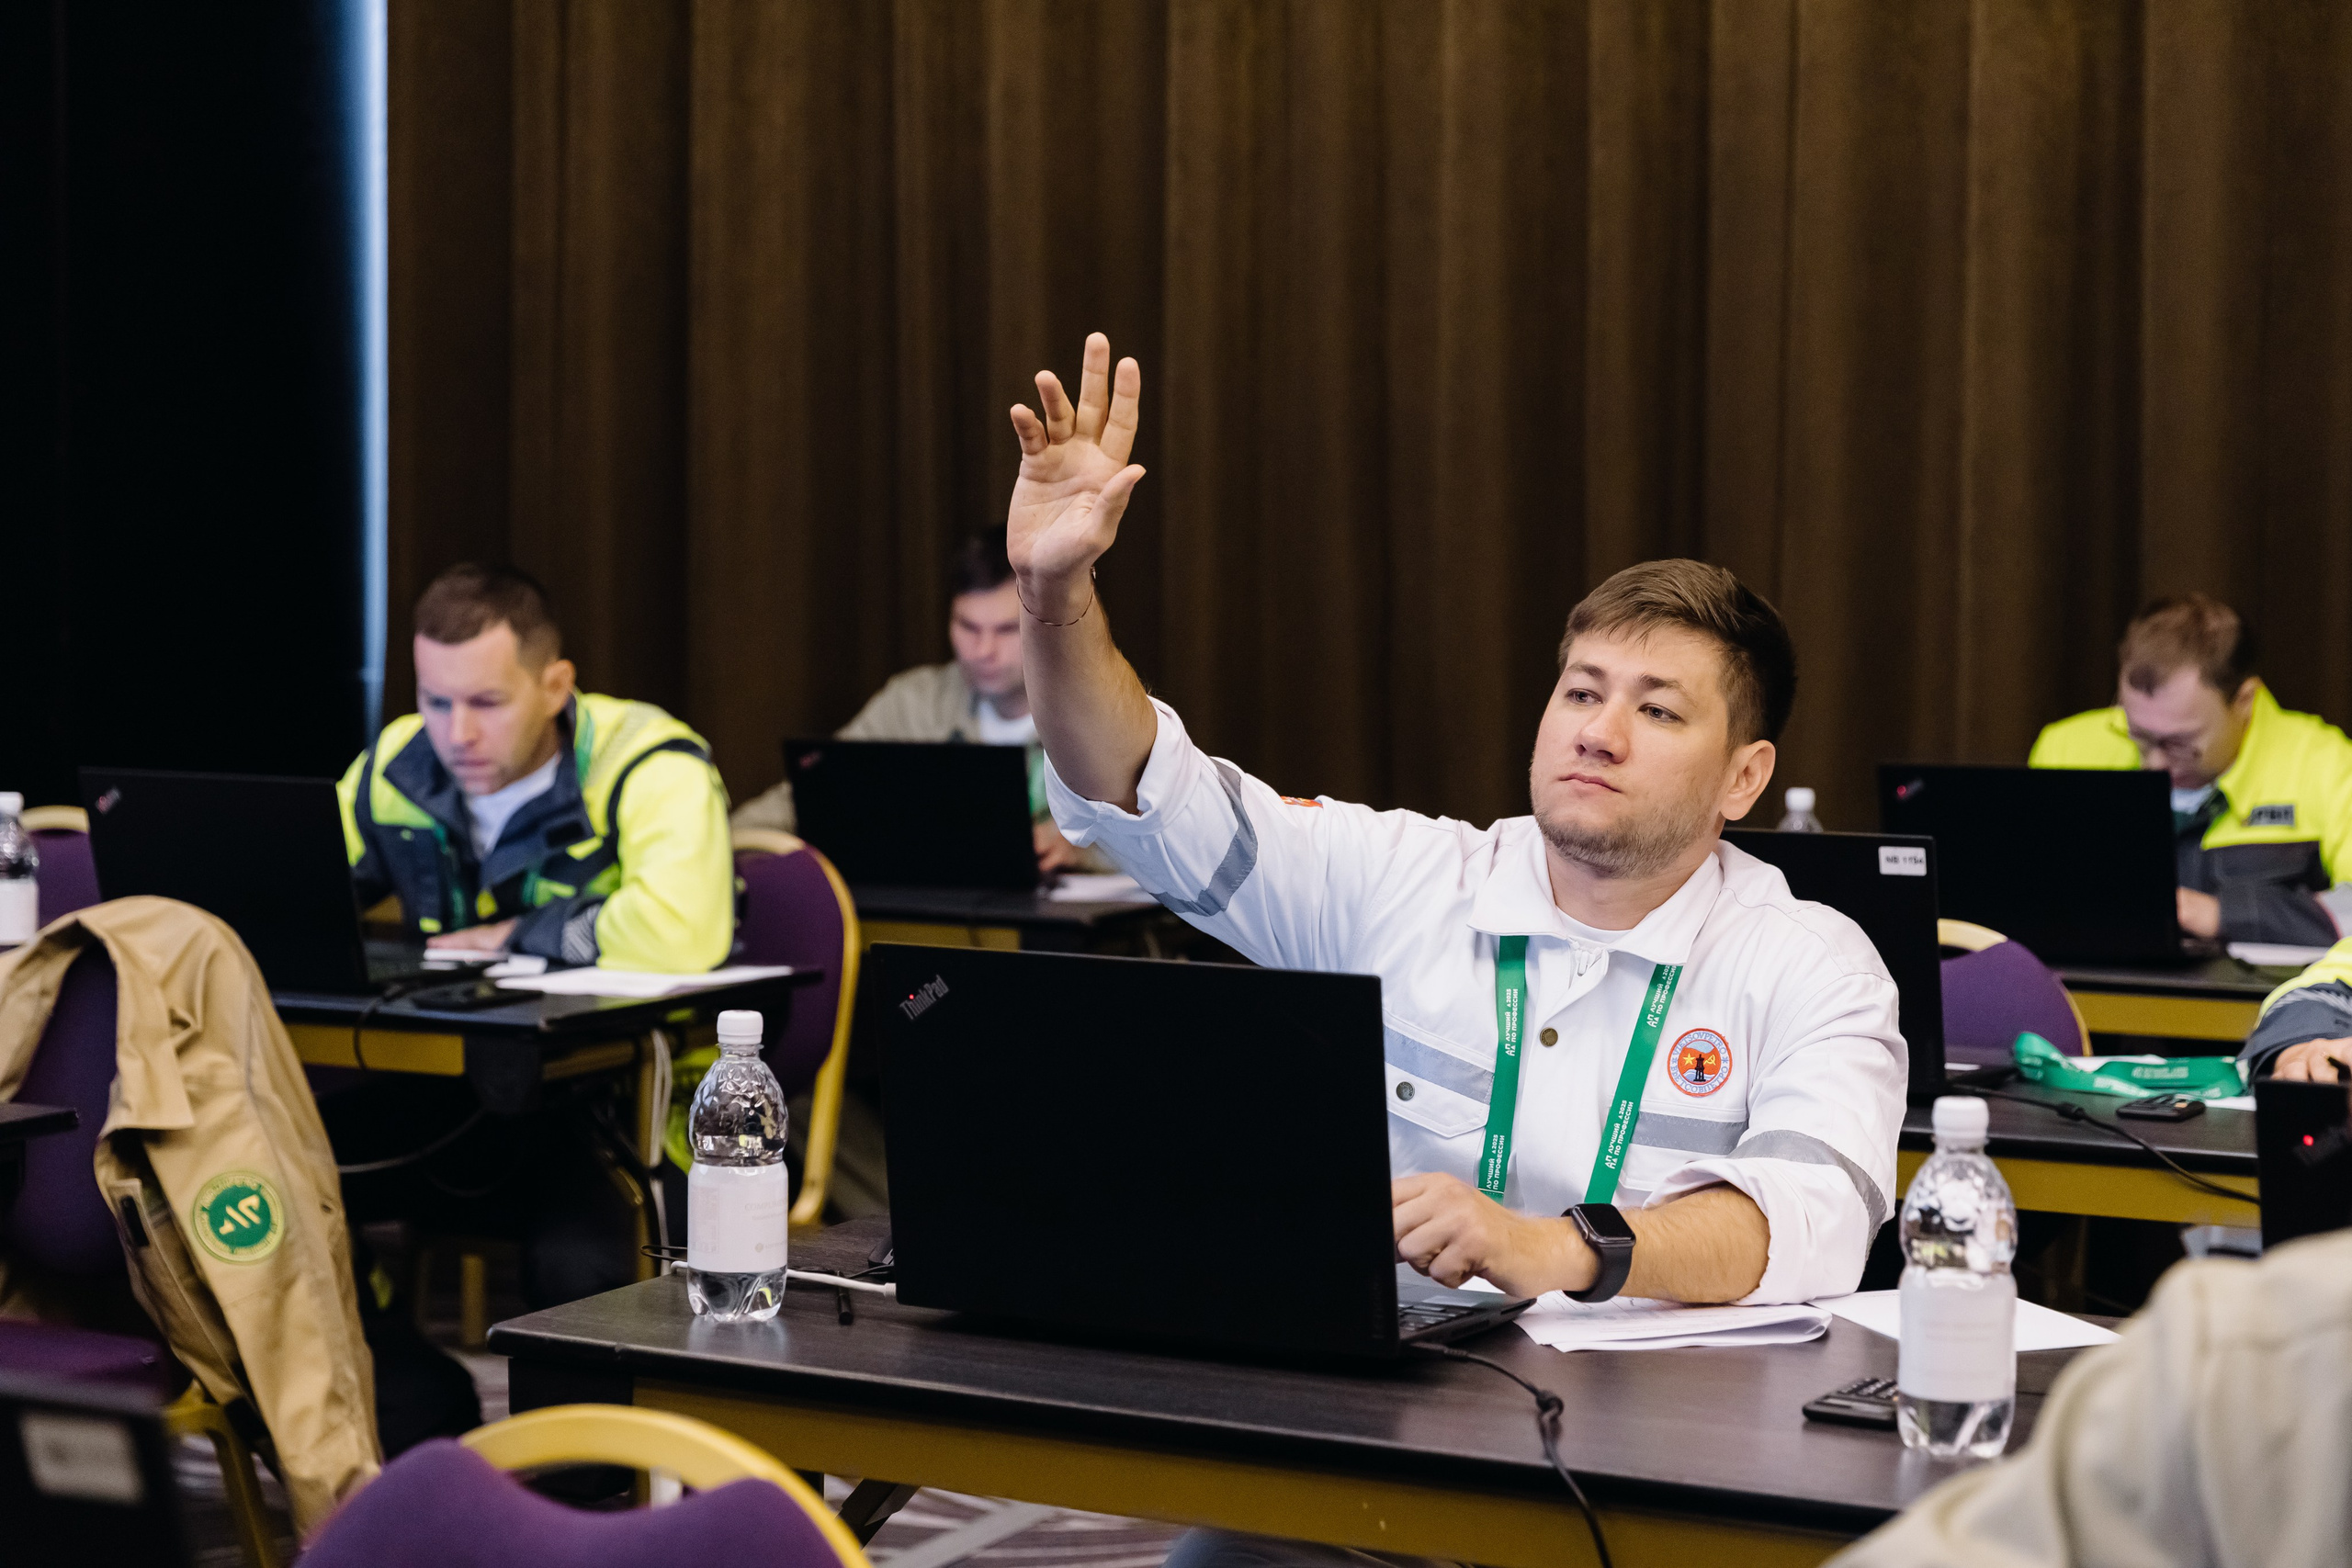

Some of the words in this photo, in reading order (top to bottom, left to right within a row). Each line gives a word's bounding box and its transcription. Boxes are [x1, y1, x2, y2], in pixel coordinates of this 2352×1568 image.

[899, 974, 950, 1020] ThinkPad
[1650, 984, 1664, 1012] ЛУЧШИЙ
[1656, 1005, 1664, 1015] ПО
[1511, 1032, 1516, 1042] ПО
[1673, 1032, 1726, 1055] VIETSOVPETRO
[1608, 1123, 1620, 1153] ЛУЧШИЙ
[1619, 1100, 1627, 1115] 2025
[1617, 1101, 1634, 1144] ПРОФЕССИИ
[1495, 1135, 1505, 1178] ПРОФЕССИИ
[1613, 1145, 1622, 1156] ПО
[1487, 1158, 1495, 1189] ЛУЧШИЙ
[1493, 1179, 1499, 1190] ПО
